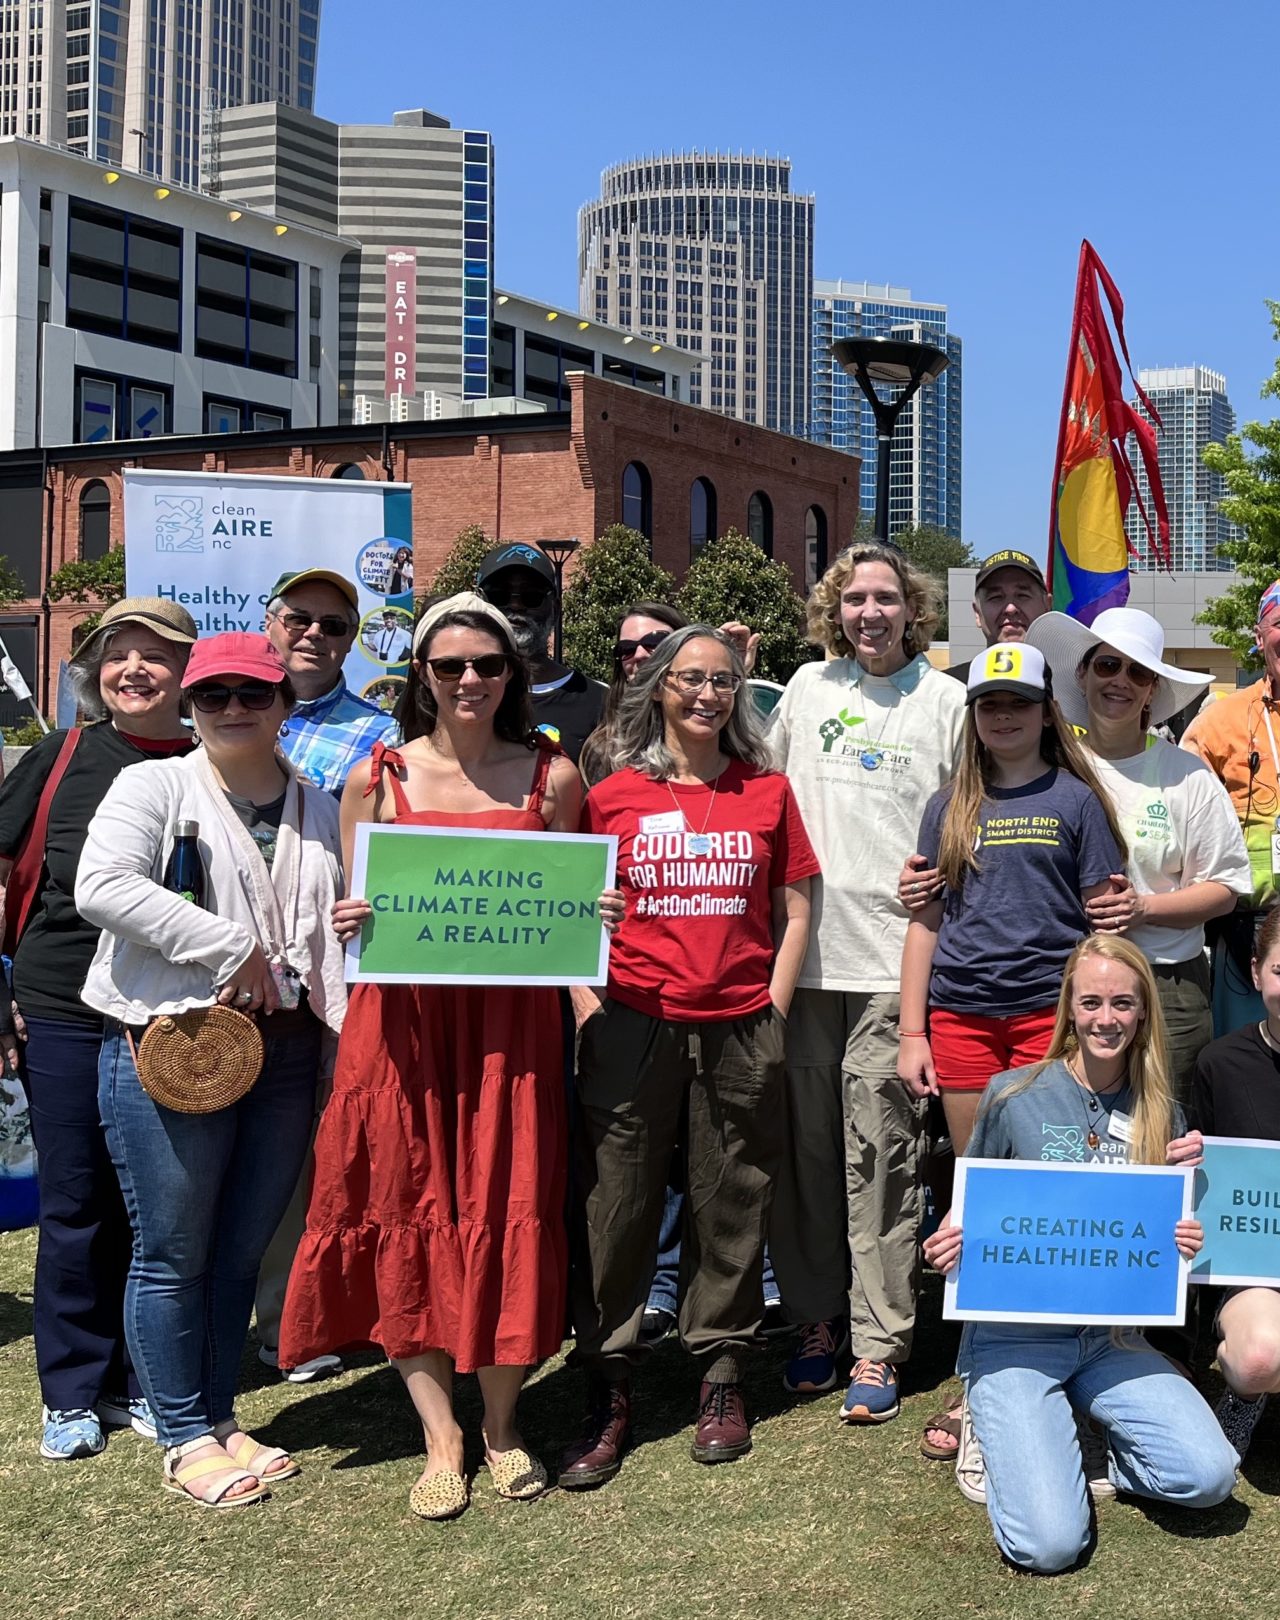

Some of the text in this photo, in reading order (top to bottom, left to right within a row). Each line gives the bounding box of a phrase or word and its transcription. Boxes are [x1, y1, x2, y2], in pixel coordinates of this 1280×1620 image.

[394, 281, 408, 395] EAT DRI
[211, 501, 256, 516] clean
[211, 518, 273, 537] AIRE
[212, 539, 232, 550] nc
[362, 567, 391, 576] CLIMATE
[157, 584, 250, 612] Healthy
[993, 651, 1014, 673] 5
[986, 816, 1059, 828] NORTH END
[986, 828, 1058, 837] SMART DISTRICT
[434, 868, 544, 889] MAKING
[627, 861, 758, 889] FOR HUMANITY
[372, 894, 596, 919] CLIMATE ACTION
[636, 892, 747, 917] #ActOnClimate
[416, 924, 552, 945] A REALITY
[1000, 1216, 1147, 1239] CREATING A
[982, 1245, 1161, 1268] HEALTHIER NC
